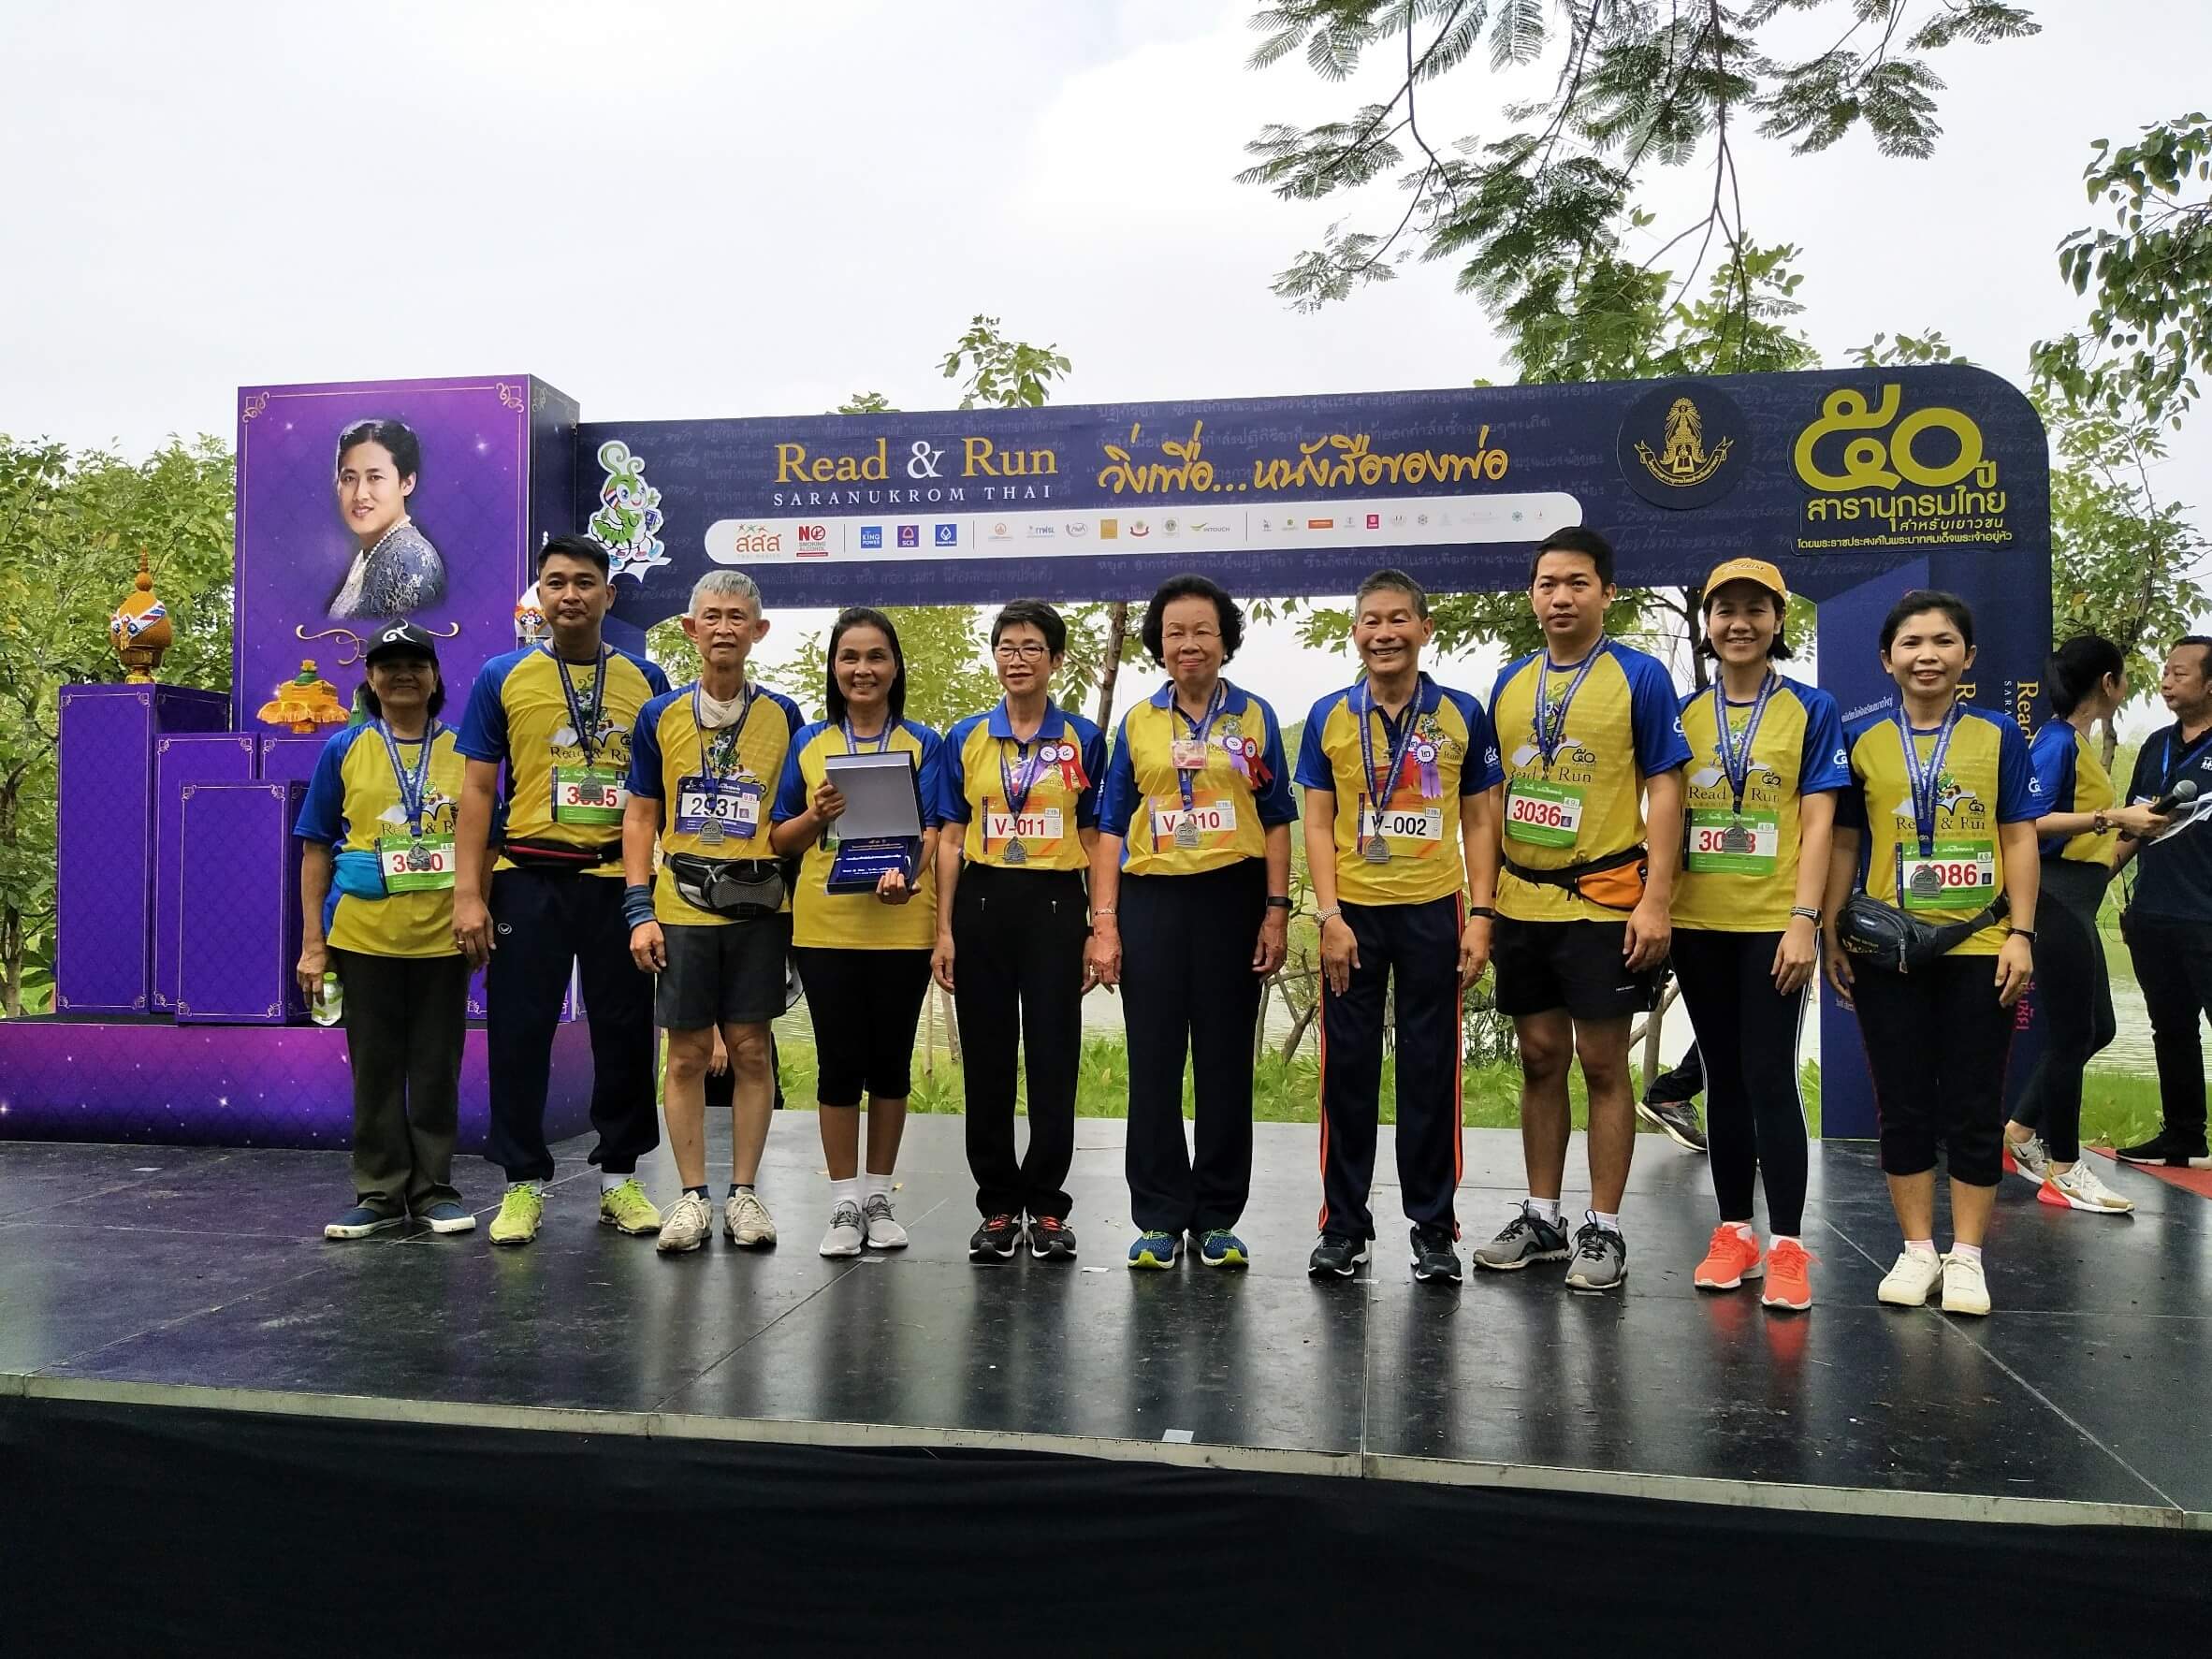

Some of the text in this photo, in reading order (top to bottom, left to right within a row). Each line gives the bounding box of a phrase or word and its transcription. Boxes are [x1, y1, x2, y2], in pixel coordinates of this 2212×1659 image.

[774, 436, 1059, 483] Read & Run
[773, 485, 1051, 507] SARANUKROM THAI
[1807, 485, 2006, 532] สารานุกรมไทย
[1899, 517, 2004, 531] สำหรับเยาวชน
[1559, 767, 1592, 782] Run
[567, 787, 618, 808] 35
[1688, 787, 1727, 800] Read
[691, 797, 739, 819] 2931
[1513, 800, 1562, 826] 3036
[995, 818, 1045, 836] V-011
[1372, 816, 1427, 836] V-002
[1897, 818, 1914, 830] Re
[393, 853, 444, 873] 30
[1916, 864, 1977, 886] 086
